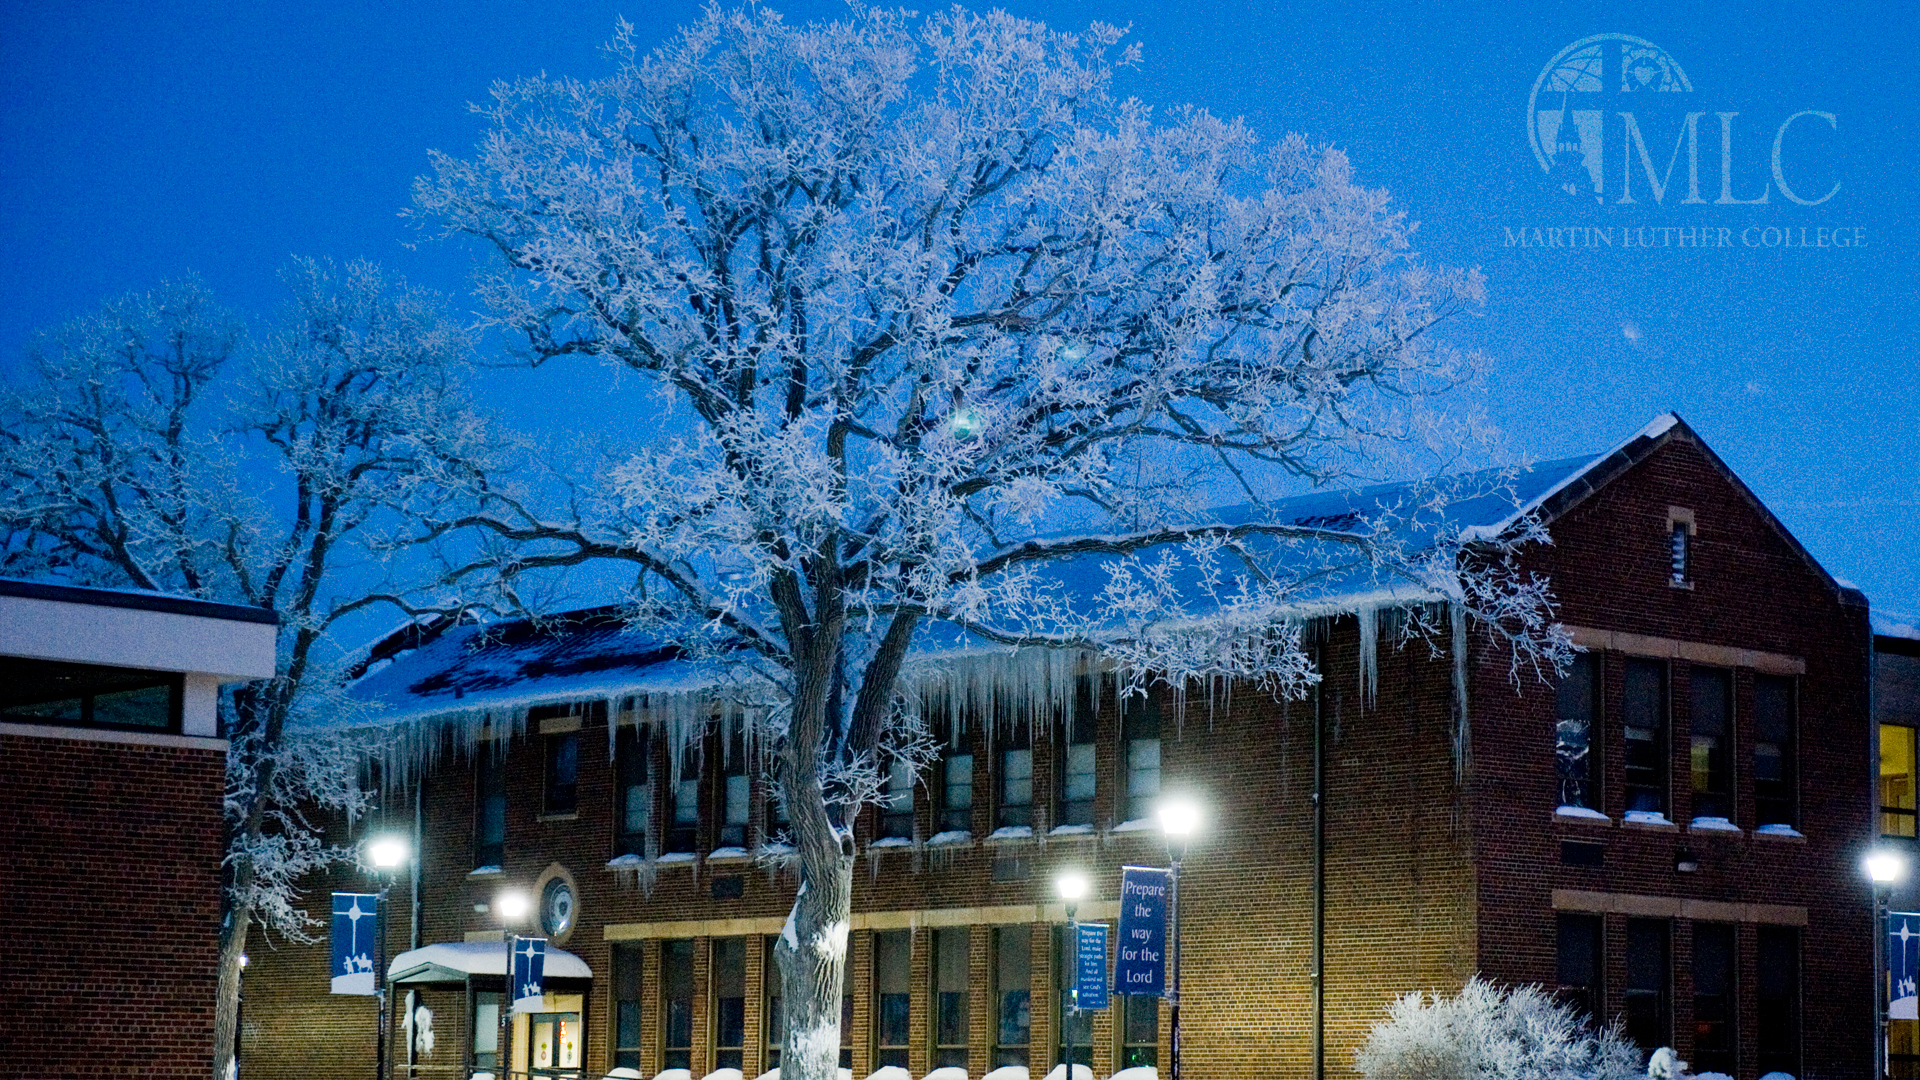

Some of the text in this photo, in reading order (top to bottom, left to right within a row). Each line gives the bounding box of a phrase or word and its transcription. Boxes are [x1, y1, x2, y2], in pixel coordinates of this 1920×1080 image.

[1125, 881, 1165, 900] Prepare
[1134, 902, 1152, 918] the
[1131, 929, 1152, 944] way
[1122, 946, 1159, 962] for the
[1126, 969, 1153, 984] Lord
